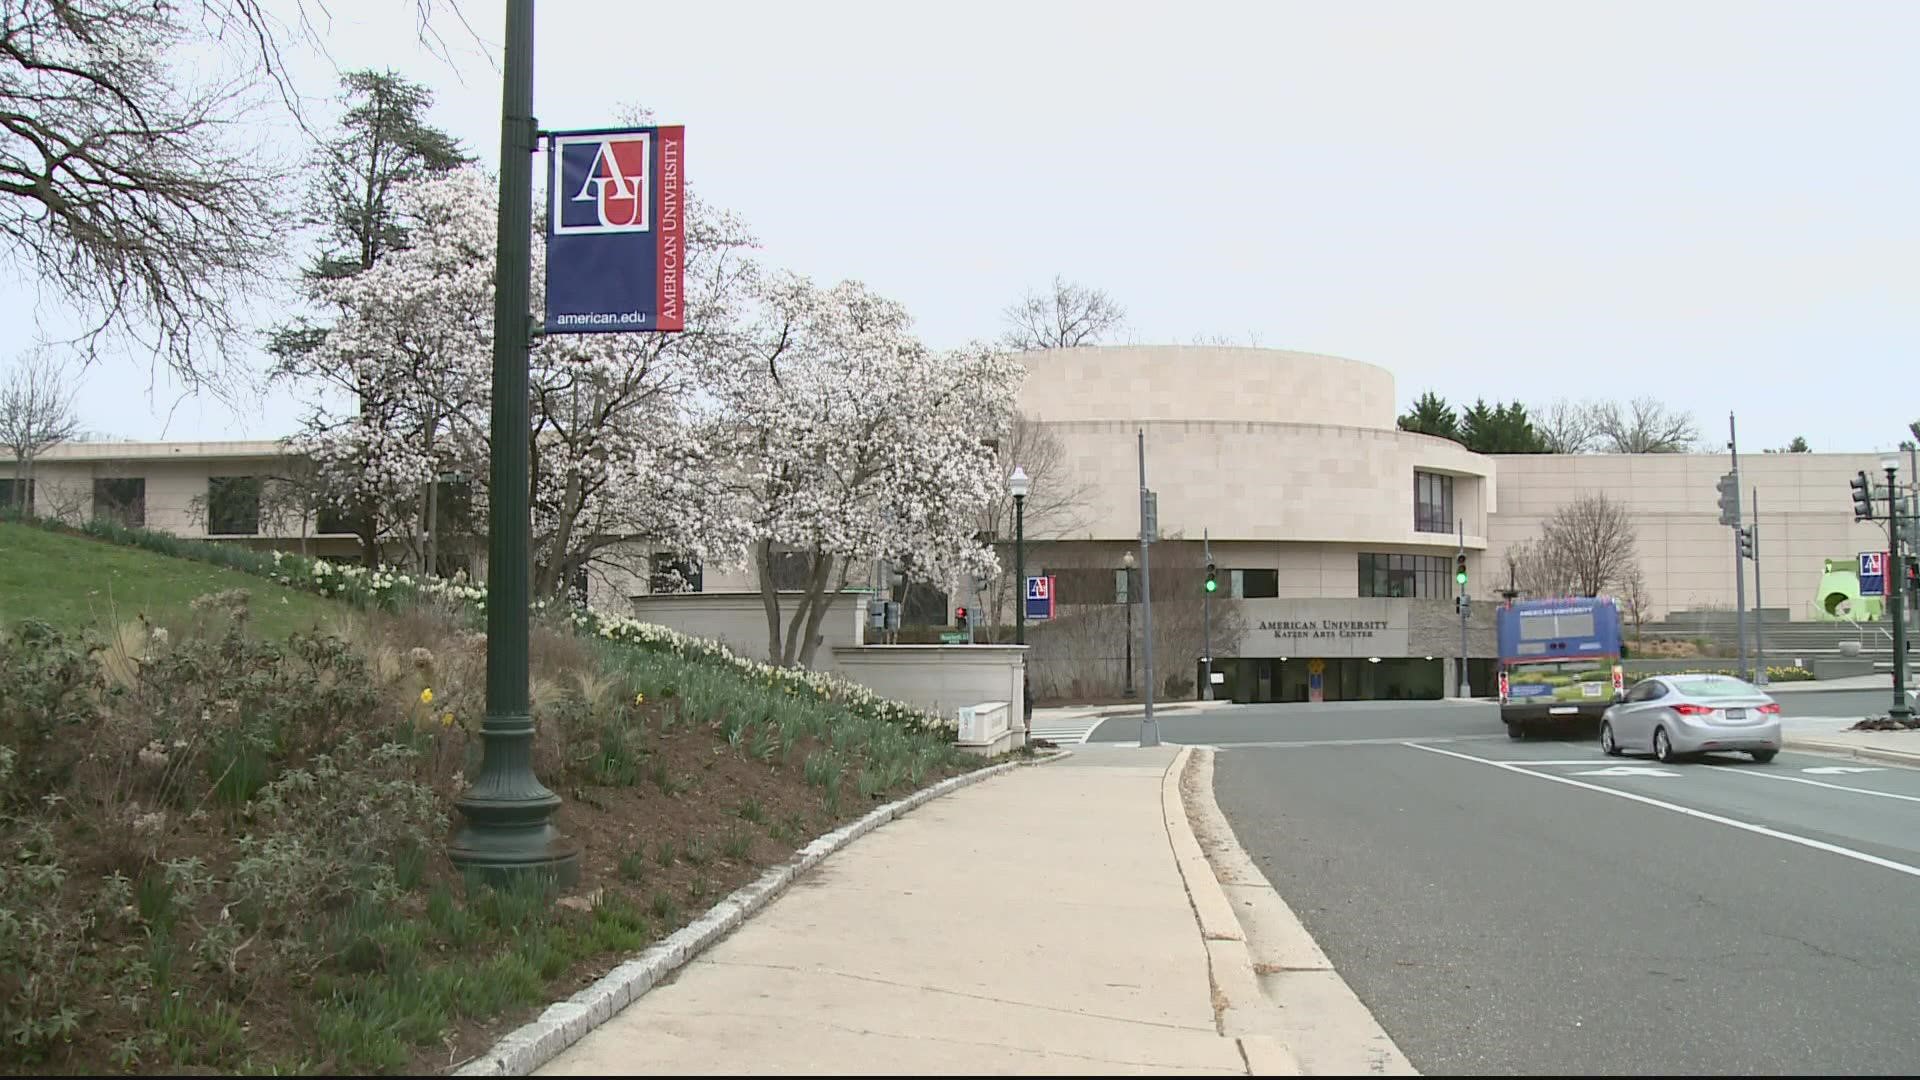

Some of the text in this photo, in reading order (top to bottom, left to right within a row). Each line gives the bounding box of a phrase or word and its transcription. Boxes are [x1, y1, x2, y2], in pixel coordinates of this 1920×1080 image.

[571, 139, 644, 227] AU
[662, 139, 679, 320] AMERICAN UNIVERSITY
[557, 311, 646, 325] american.edu
[1259, 620, 1388, 630] AMERICAN UNIVERSITY
[1274, 630, 1373, 639] KATZEN ARTS CENTER
